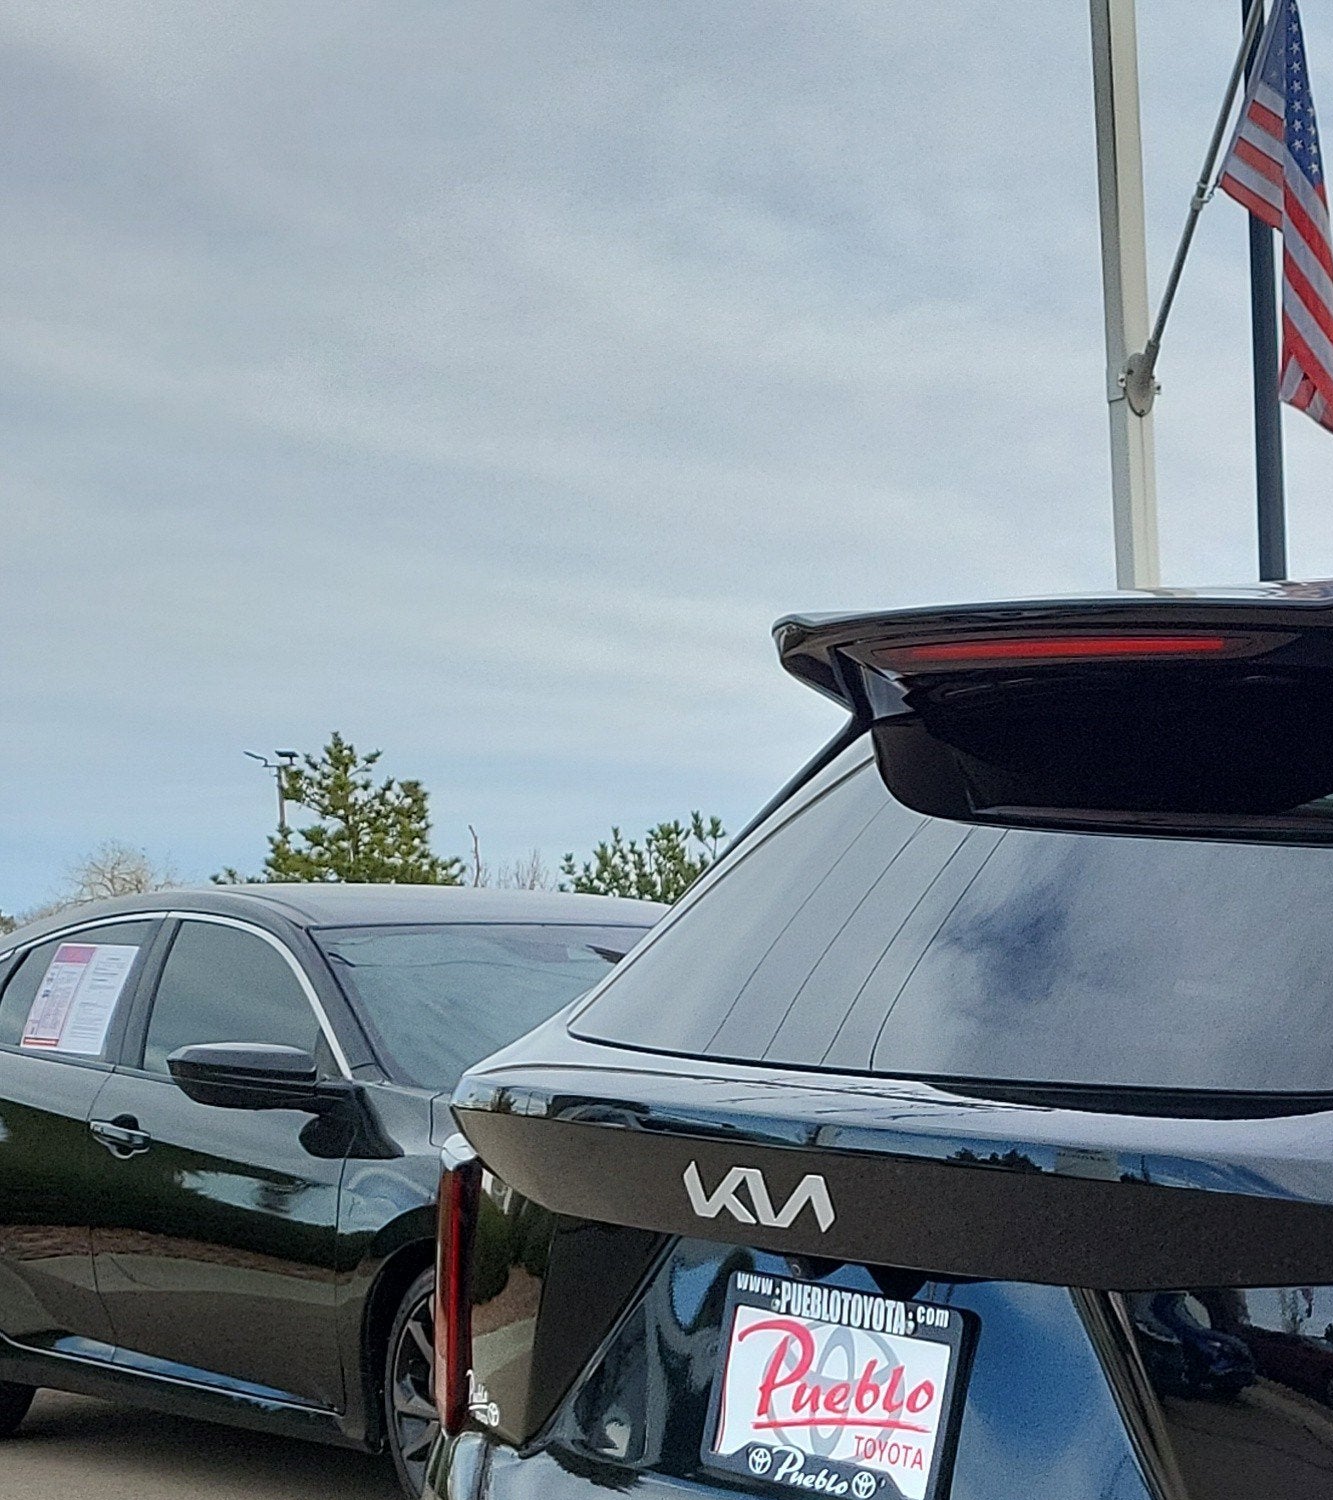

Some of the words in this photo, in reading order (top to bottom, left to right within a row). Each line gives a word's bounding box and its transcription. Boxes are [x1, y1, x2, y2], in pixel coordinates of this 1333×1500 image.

[683, 1160, 836, 1233] KIA
[737, 1318, 935, 1416] Pueblo
[771, 1444, 849, 1496] Pueblo
[854, 1434, 923, 1470] TOYOTA
